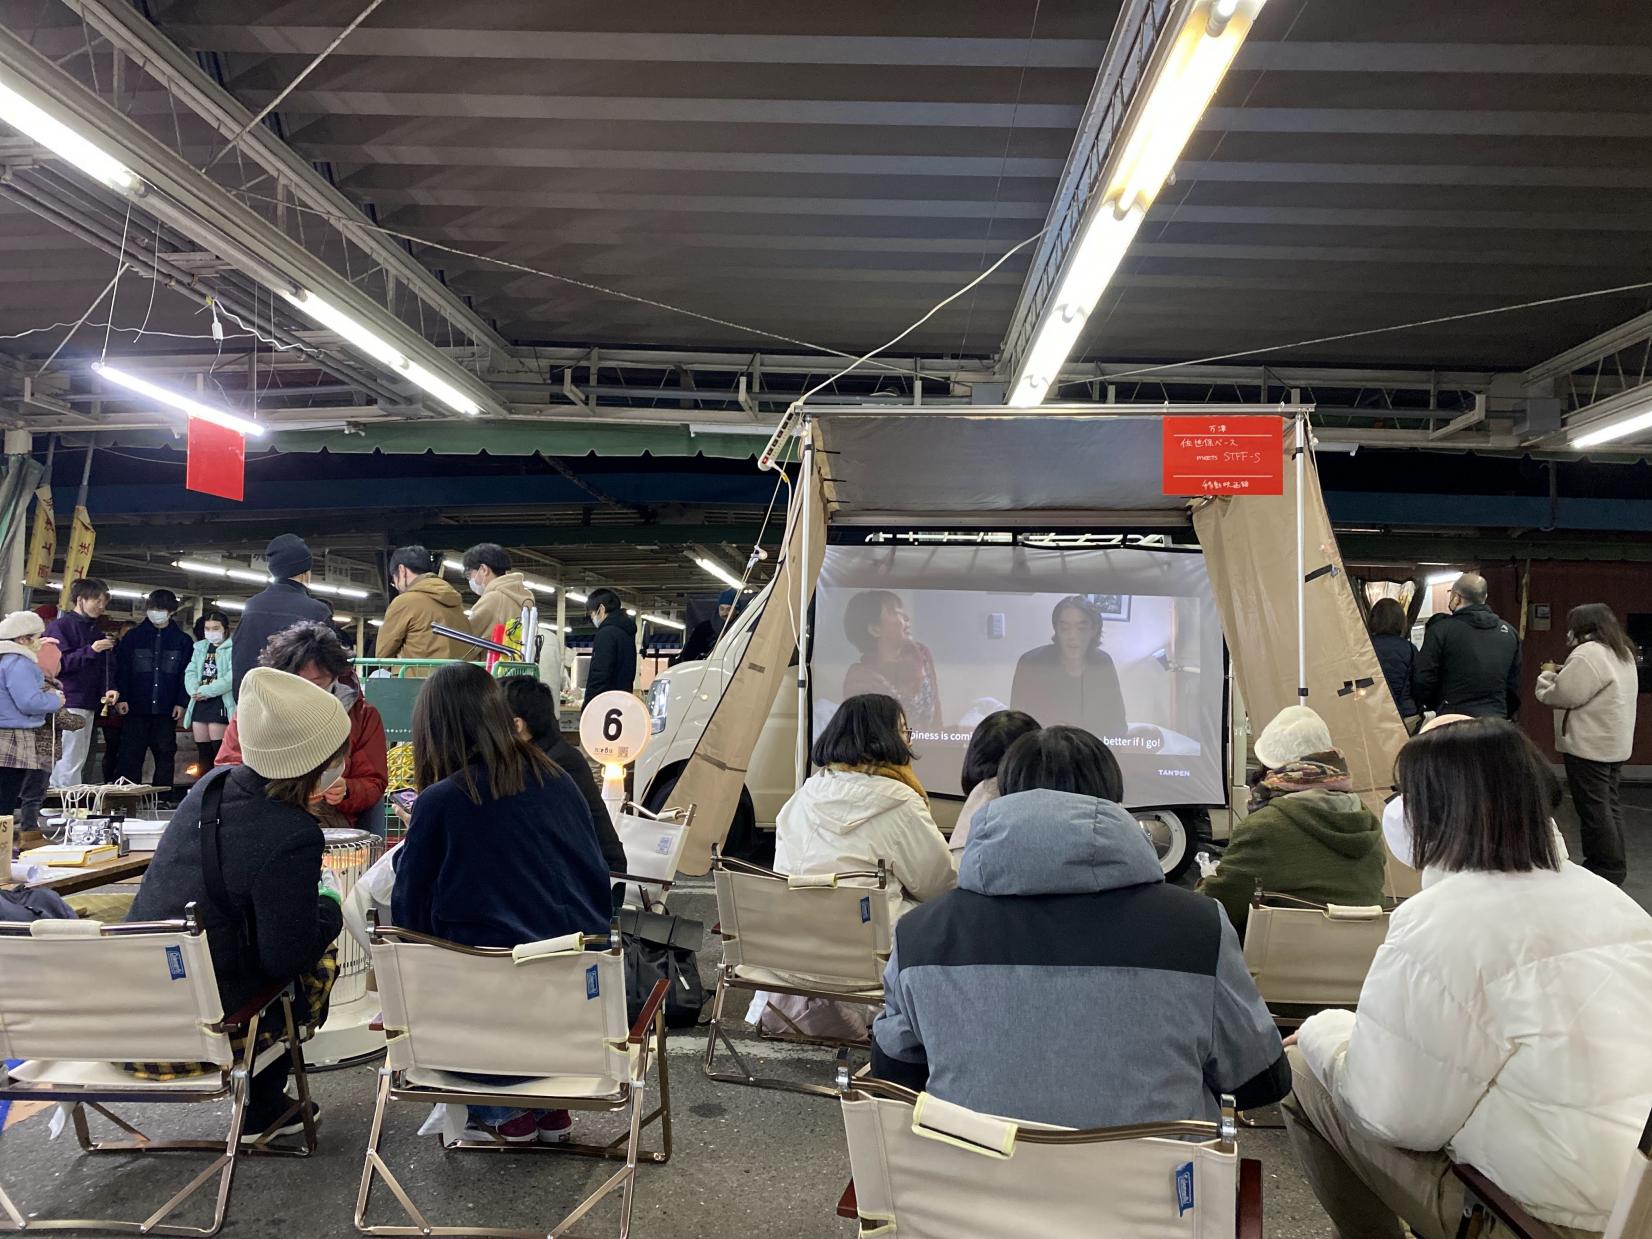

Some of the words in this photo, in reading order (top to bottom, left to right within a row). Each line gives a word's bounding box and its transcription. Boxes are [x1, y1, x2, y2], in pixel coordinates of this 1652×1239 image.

[602, 708, 623, 742] 6
[910, 730, 940, 741] piness
[941, 730, 949, 740] is
[950, 731, 973, 741] comi
[1103, 735, 1132, 747] better
[1132, 736, 1140, 747] if
[1146, 738, 1161, 749] go!
